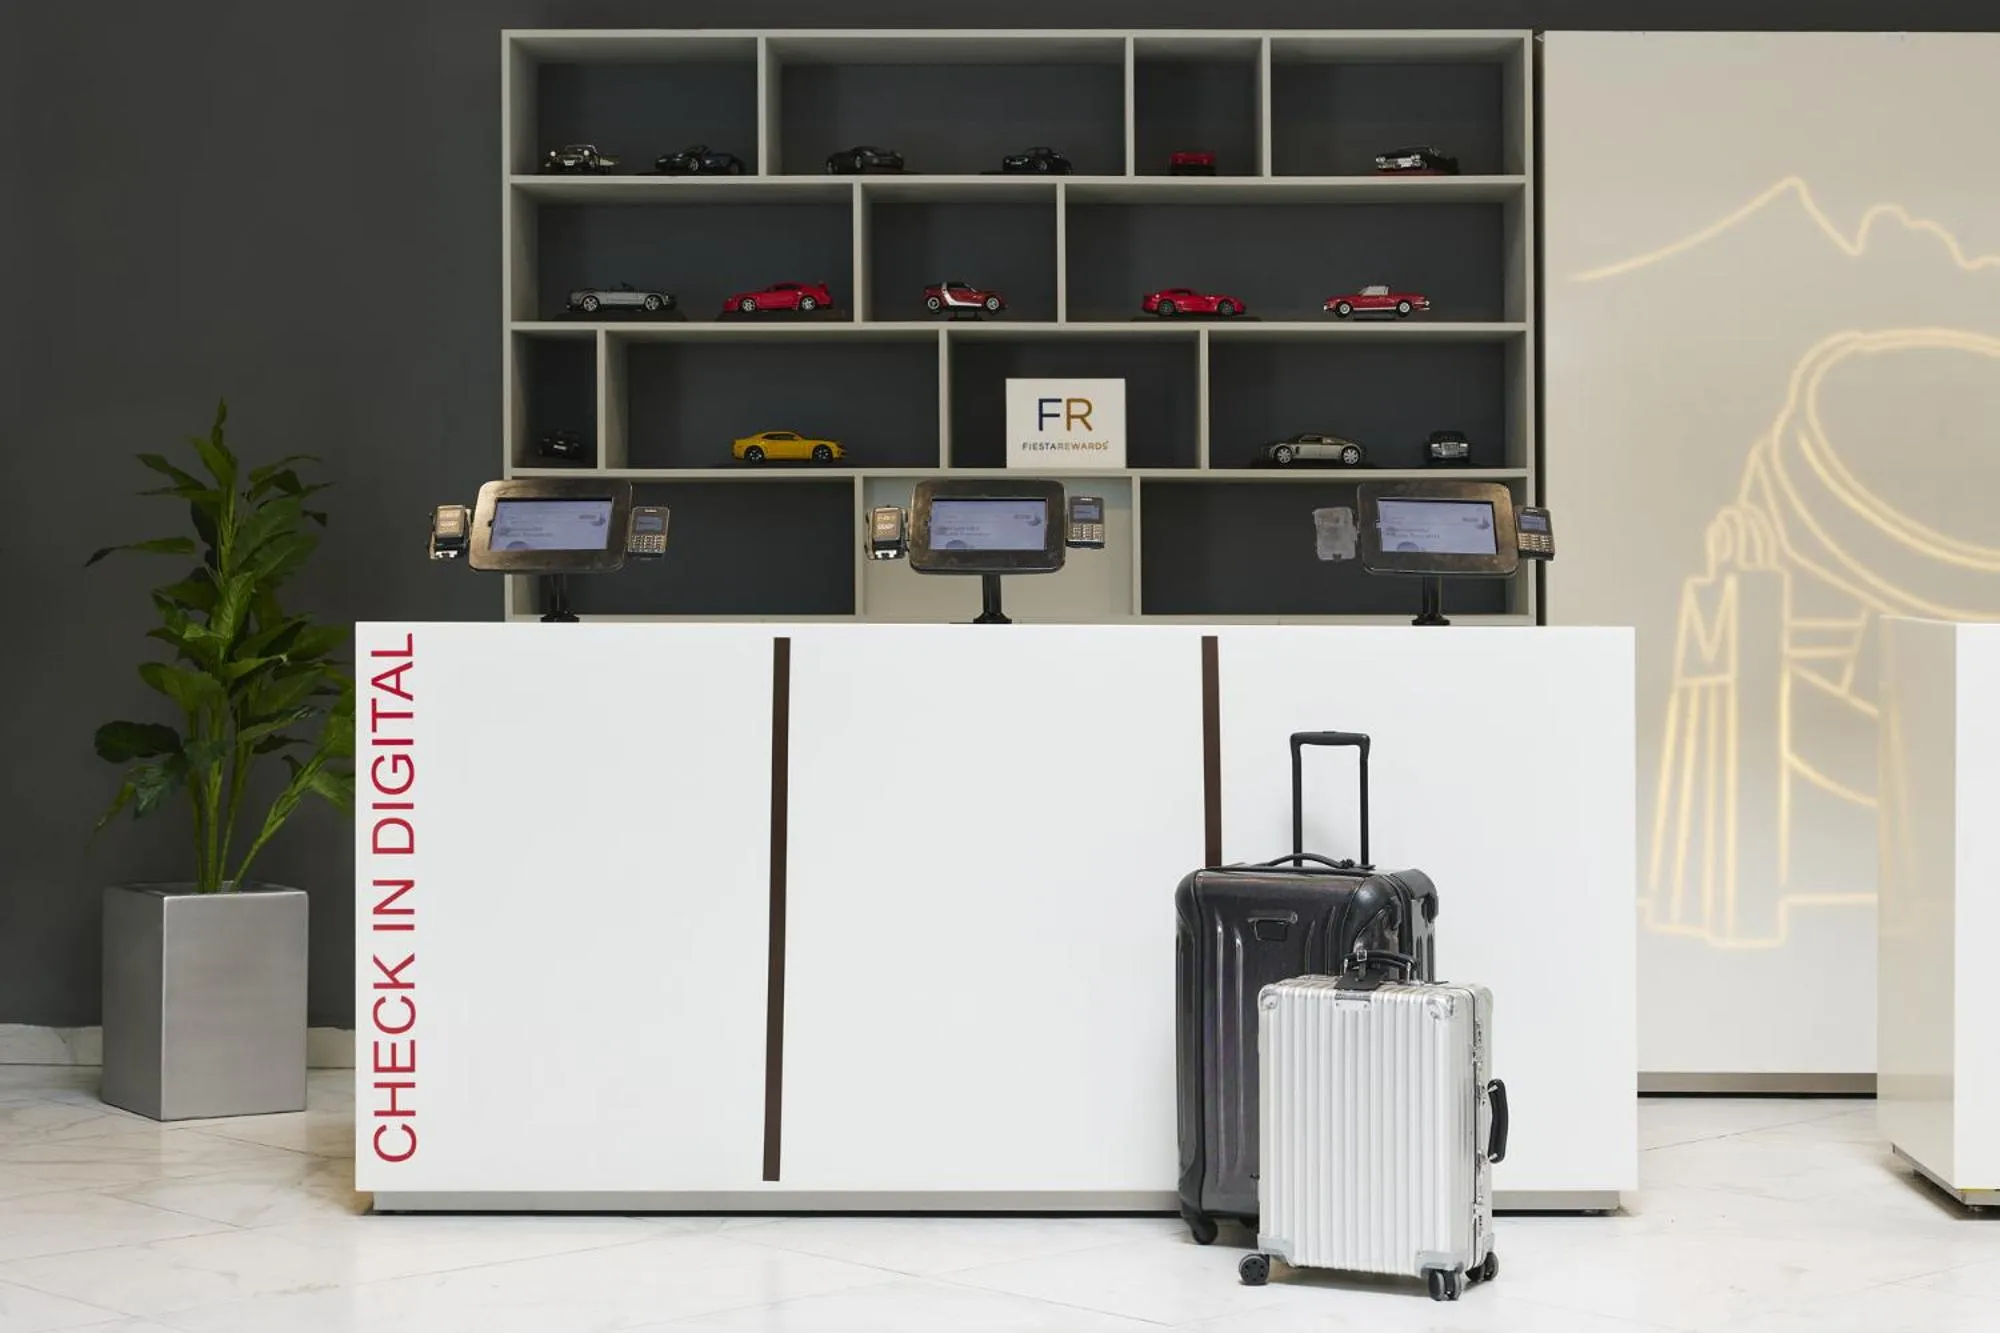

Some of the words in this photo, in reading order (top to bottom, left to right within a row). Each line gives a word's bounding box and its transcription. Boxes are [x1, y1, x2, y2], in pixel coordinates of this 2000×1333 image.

[1038, 398, 1093, 432] FR
[370, 631, 416, 856] DIGITAL
[371, 878, 416, 932] IN
[372, 954, 417, 1164] CHECK
